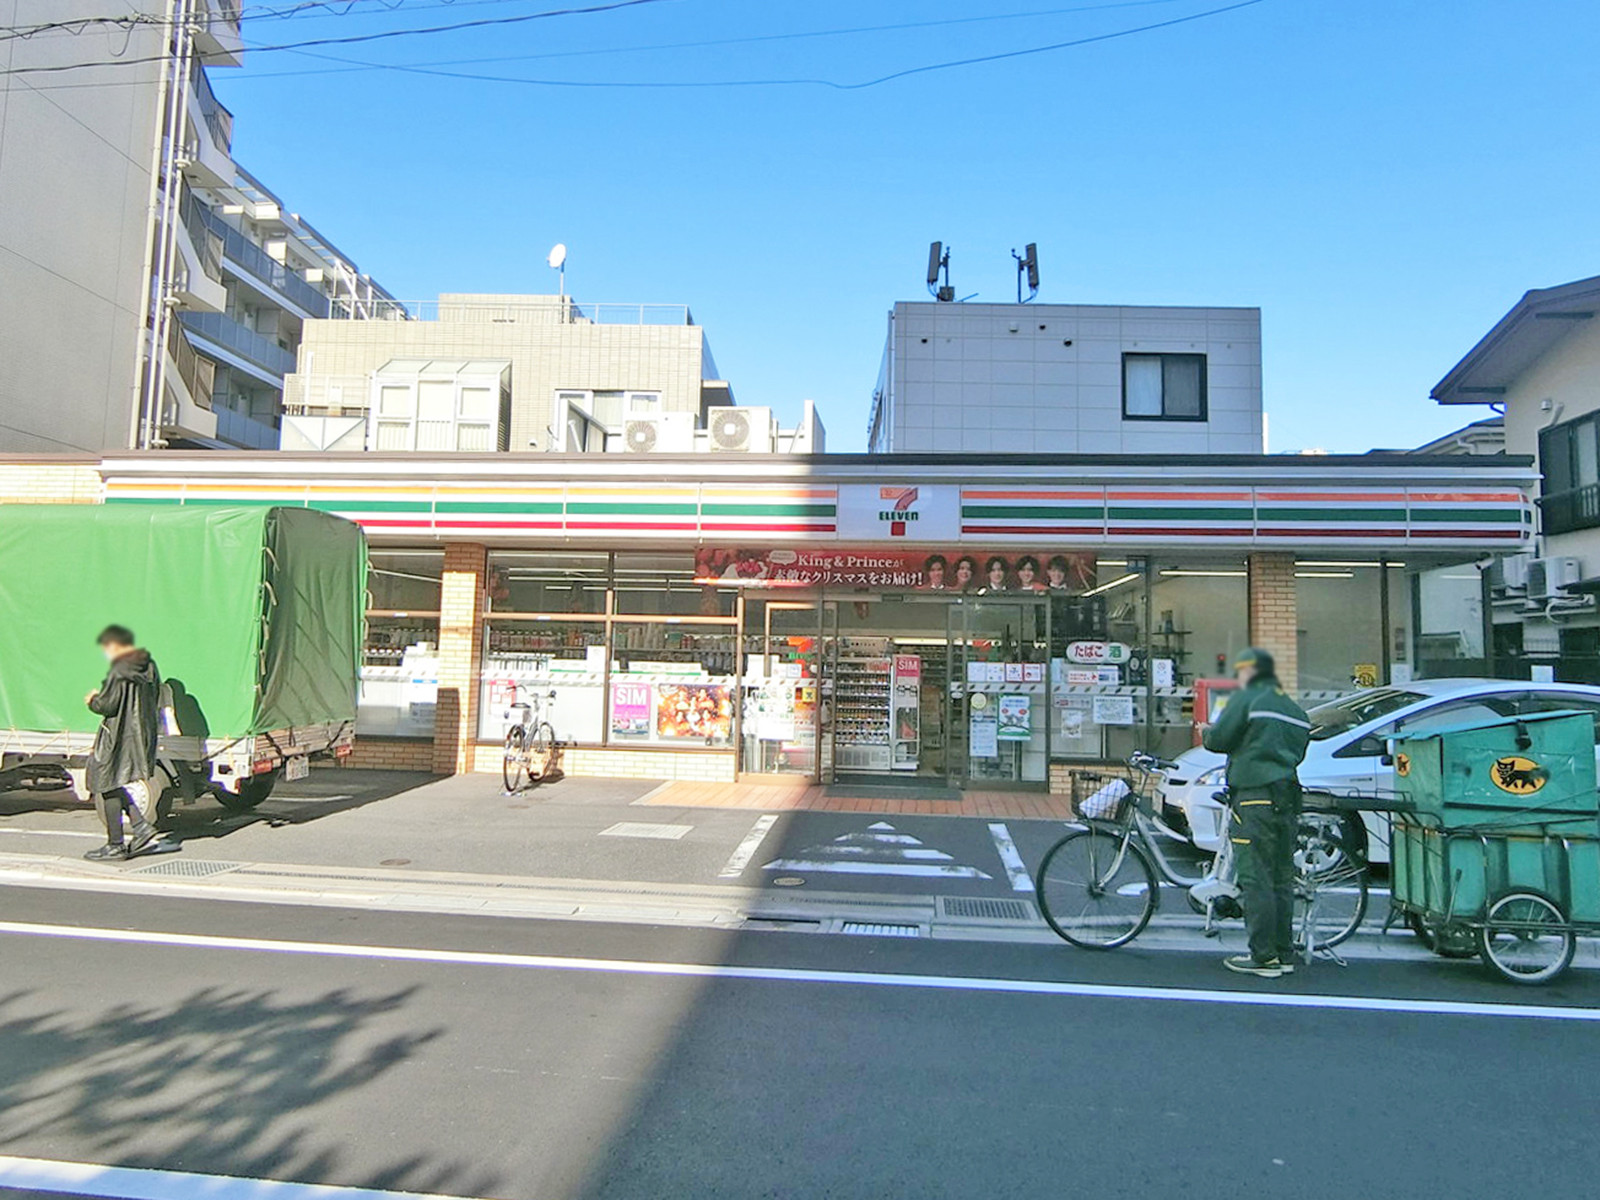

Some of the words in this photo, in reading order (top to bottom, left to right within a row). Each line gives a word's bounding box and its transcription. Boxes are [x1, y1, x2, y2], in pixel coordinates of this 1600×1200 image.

[798, 554, 832, 569] King
[834, 555, 845, 567] &
[1074, 645, 1104, 658] たばこ
[1108, 645, 1122, 658] 酒
[898, 660, 918, 671] SIM
[616, 688, 647, 705] SIM
